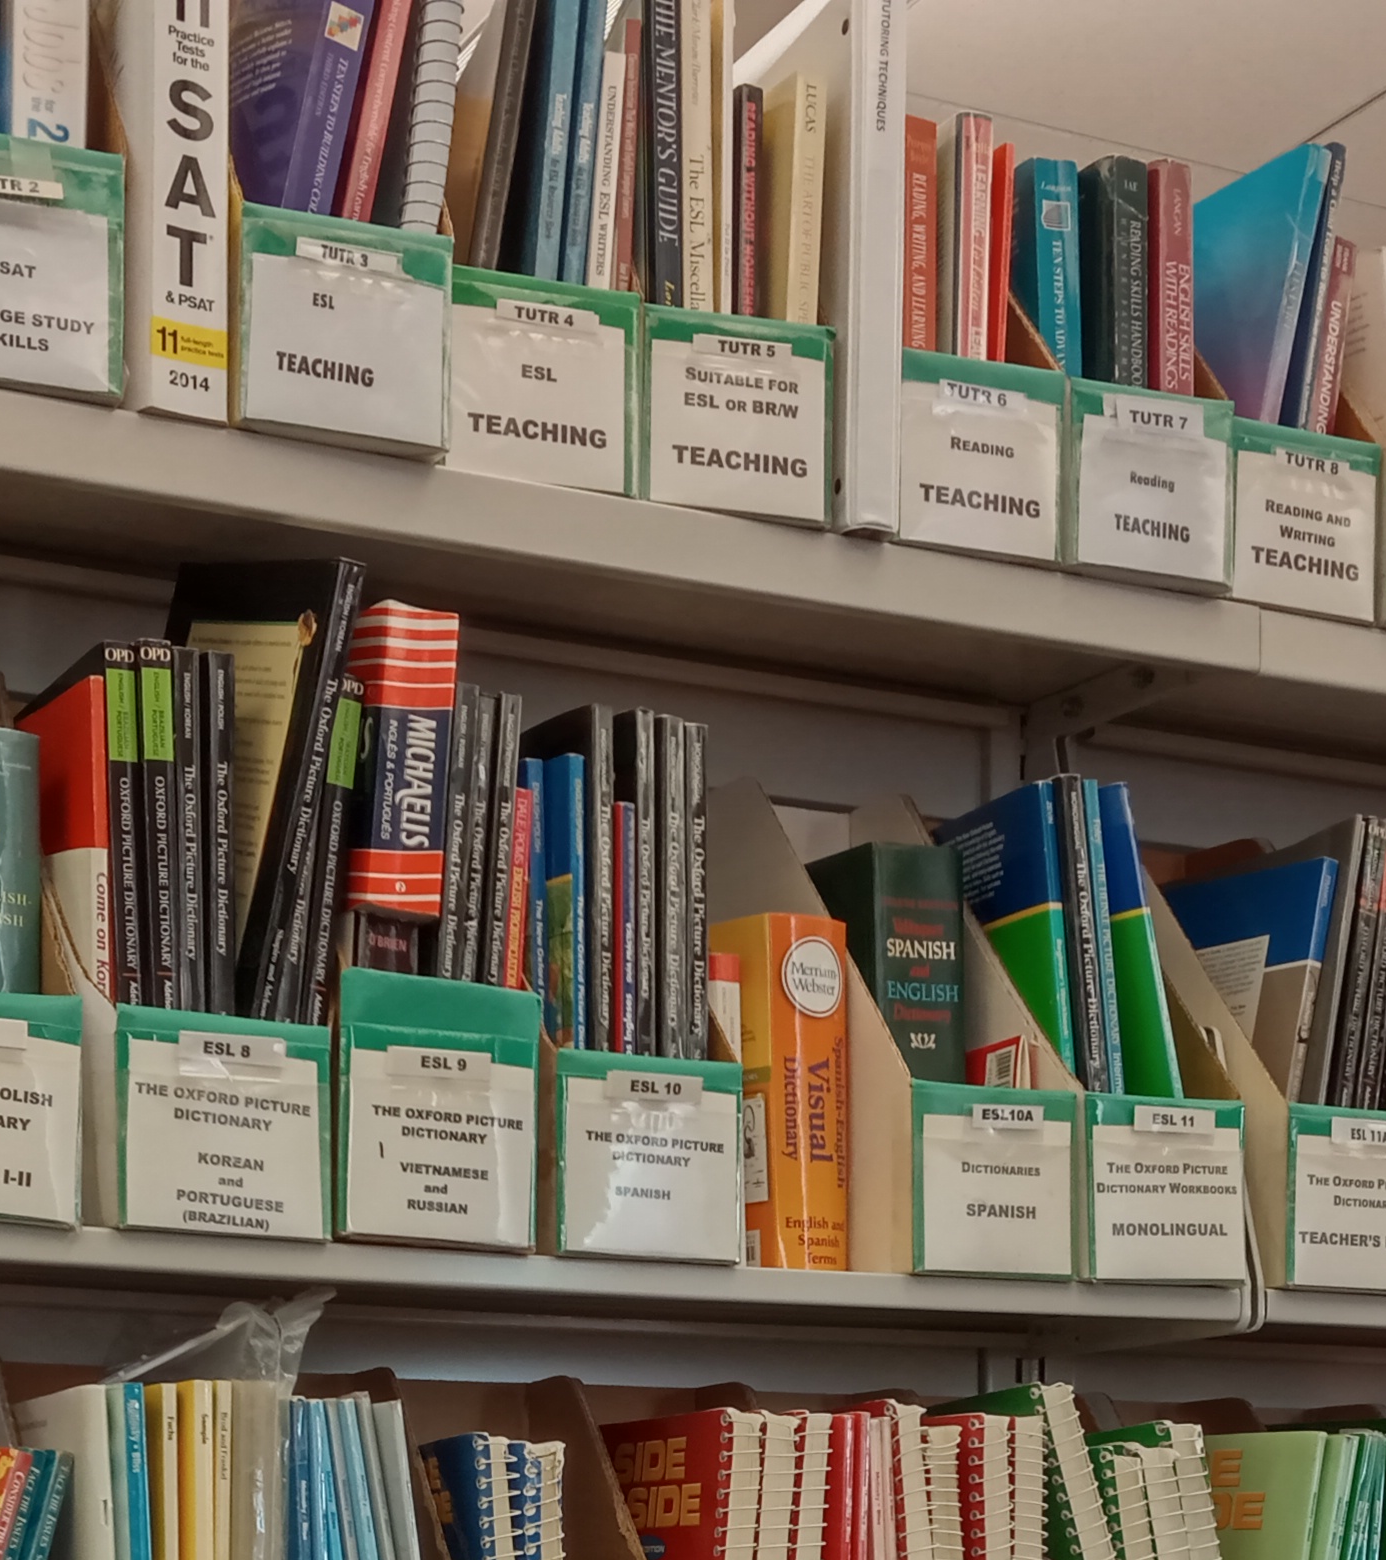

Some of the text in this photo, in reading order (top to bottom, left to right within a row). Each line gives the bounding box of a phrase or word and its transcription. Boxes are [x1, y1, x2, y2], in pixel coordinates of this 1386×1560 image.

[168, 25, 214, 51] Practice
[165, 80, 215, 287] SAT
[179, 294, 214, 311] PSAT
[32, 314, 94, 334] STUDY
[515, 306, 573, 326] TUTR 4
[1179, 264, 1194, 381] ENGLISH SKILLS
[1314, 299, 1341, 435] UNDERSTANDING
[170, 370, 209, 392] 2014
[684, 392, 719, 409] ESL
[753, 401, 798, 418] BR/W
[468, 413, 606, 449] TEACHING
[1130, 471, 1174, 493] Reading
[919, 483, 1040, 518] TEACHING
[400, 715, 436, 847] MICHAELIS
[887, 938, 955, 960] SPANISH
[887, 980, 958, 1002] ENGLISH
[421, 1056, 466, 1071] ESL 9
[781, 1055, 798, 1162] Dictionary
[807, 1057, 834, 1164] Visual
[982, 1109, 1033, 1121] ESL10A
[4, 1169, 31, 1187] I-II
[400, 1162, 488, 1180] VIETNAMESE
[177, 1189, 283, 1213] PORTUGUESE
[408, 1199, 467, 1214] RUSSIAN
[183, 1211, 269, 1232] (BRAZILIAN)
[1113, 1223, 1227, 1236] MONOLINGUAL
[1299, 1232, 1380, 1247] TEACHER'S
